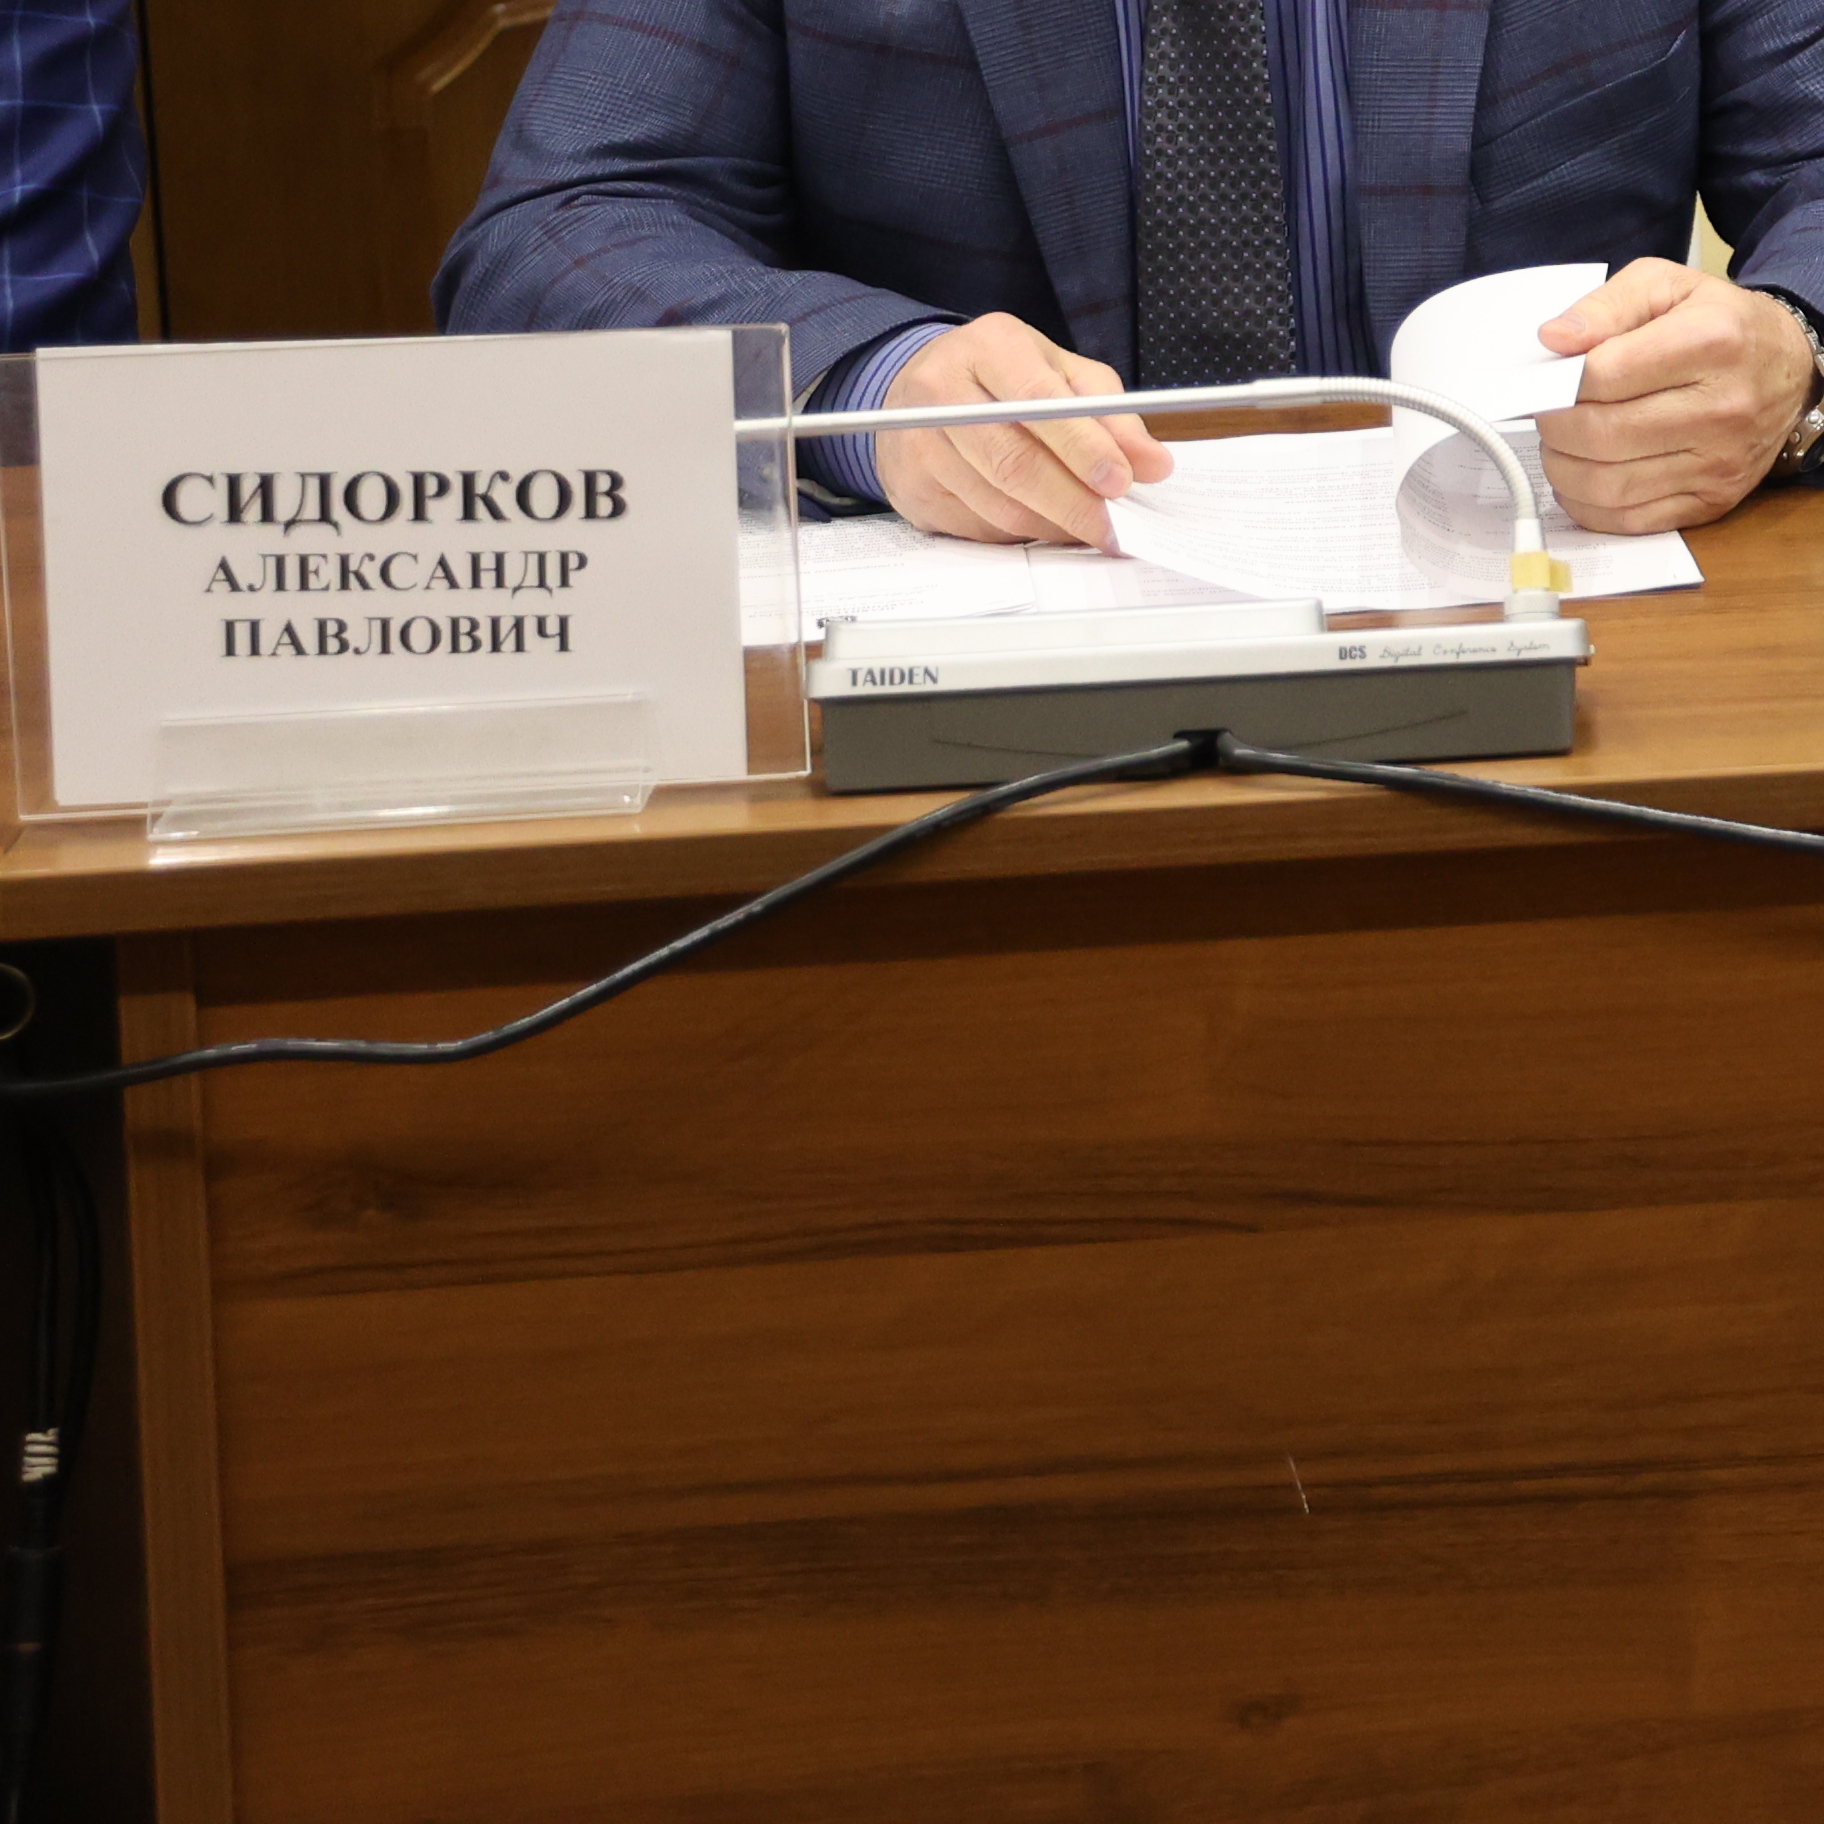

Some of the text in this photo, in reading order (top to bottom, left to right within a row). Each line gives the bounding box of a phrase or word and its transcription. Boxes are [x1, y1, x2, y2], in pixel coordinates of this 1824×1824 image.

[160, 468, 629, 537] СИДОРКОВ
[203, 549, 589, 599] АЛЕКСАНДР
[221, 613, 573, 659] ПАВЛОВИЧ
[1338, 644, 1367, 661] DCS
[1379, 644, 1423, 663] Digital
[1432, 641, 1497, 660] Conference
[847, 665, 940, 688] TAIDEN
